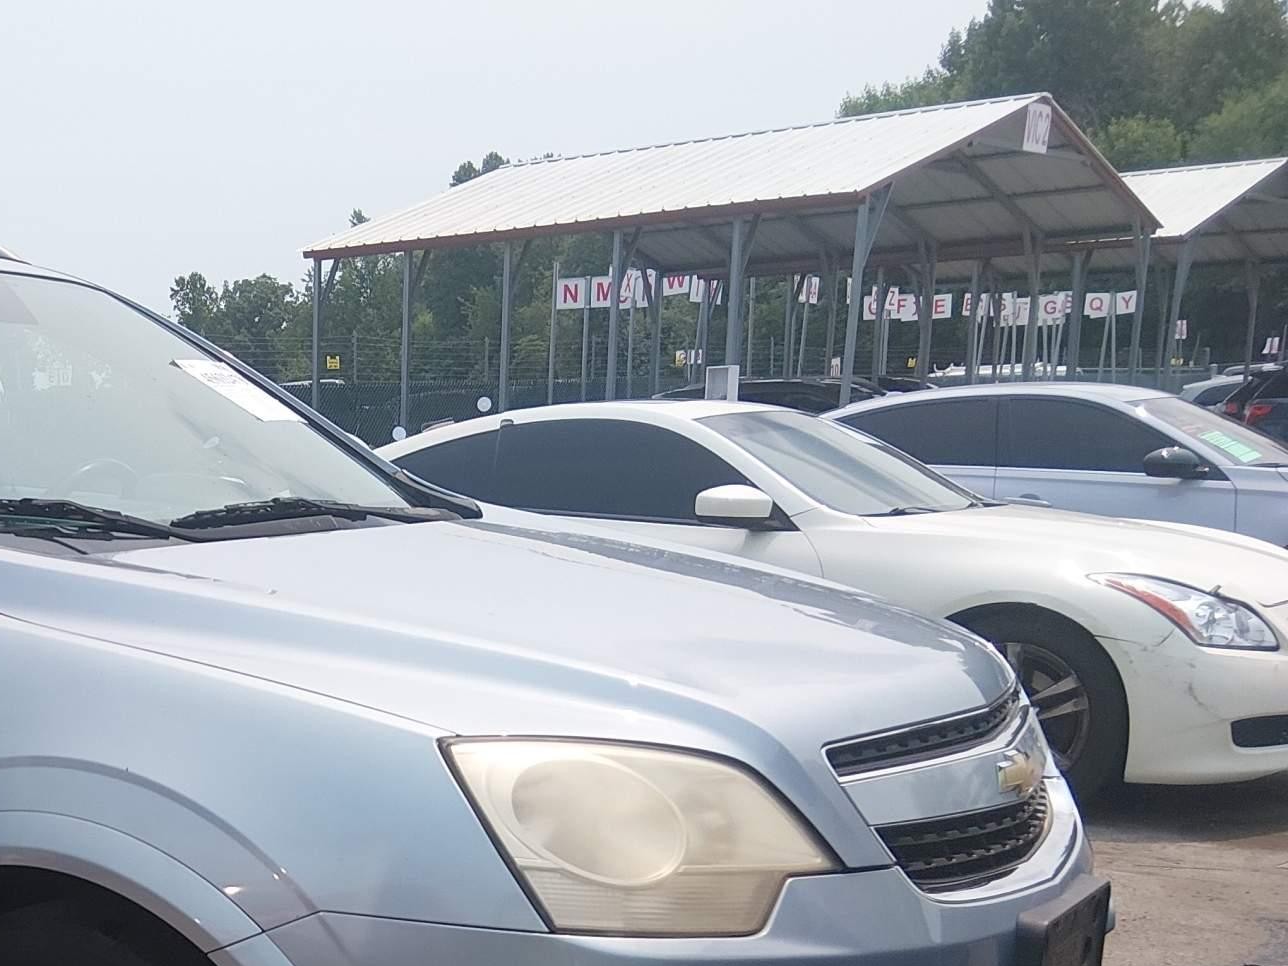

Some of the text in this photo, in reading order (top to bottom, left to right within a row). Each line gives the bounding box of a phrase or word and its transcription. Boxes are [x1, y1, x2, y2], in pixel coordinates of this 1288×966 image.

[563, 284, 578, 304] N
[596, 281, 612, 302] M
[934, 298, 947, 315] E
[1044, 300, 1057, 315] G
[1089, 296, 1104, 312] Q
[1121, 295, 1134, 310] Y
